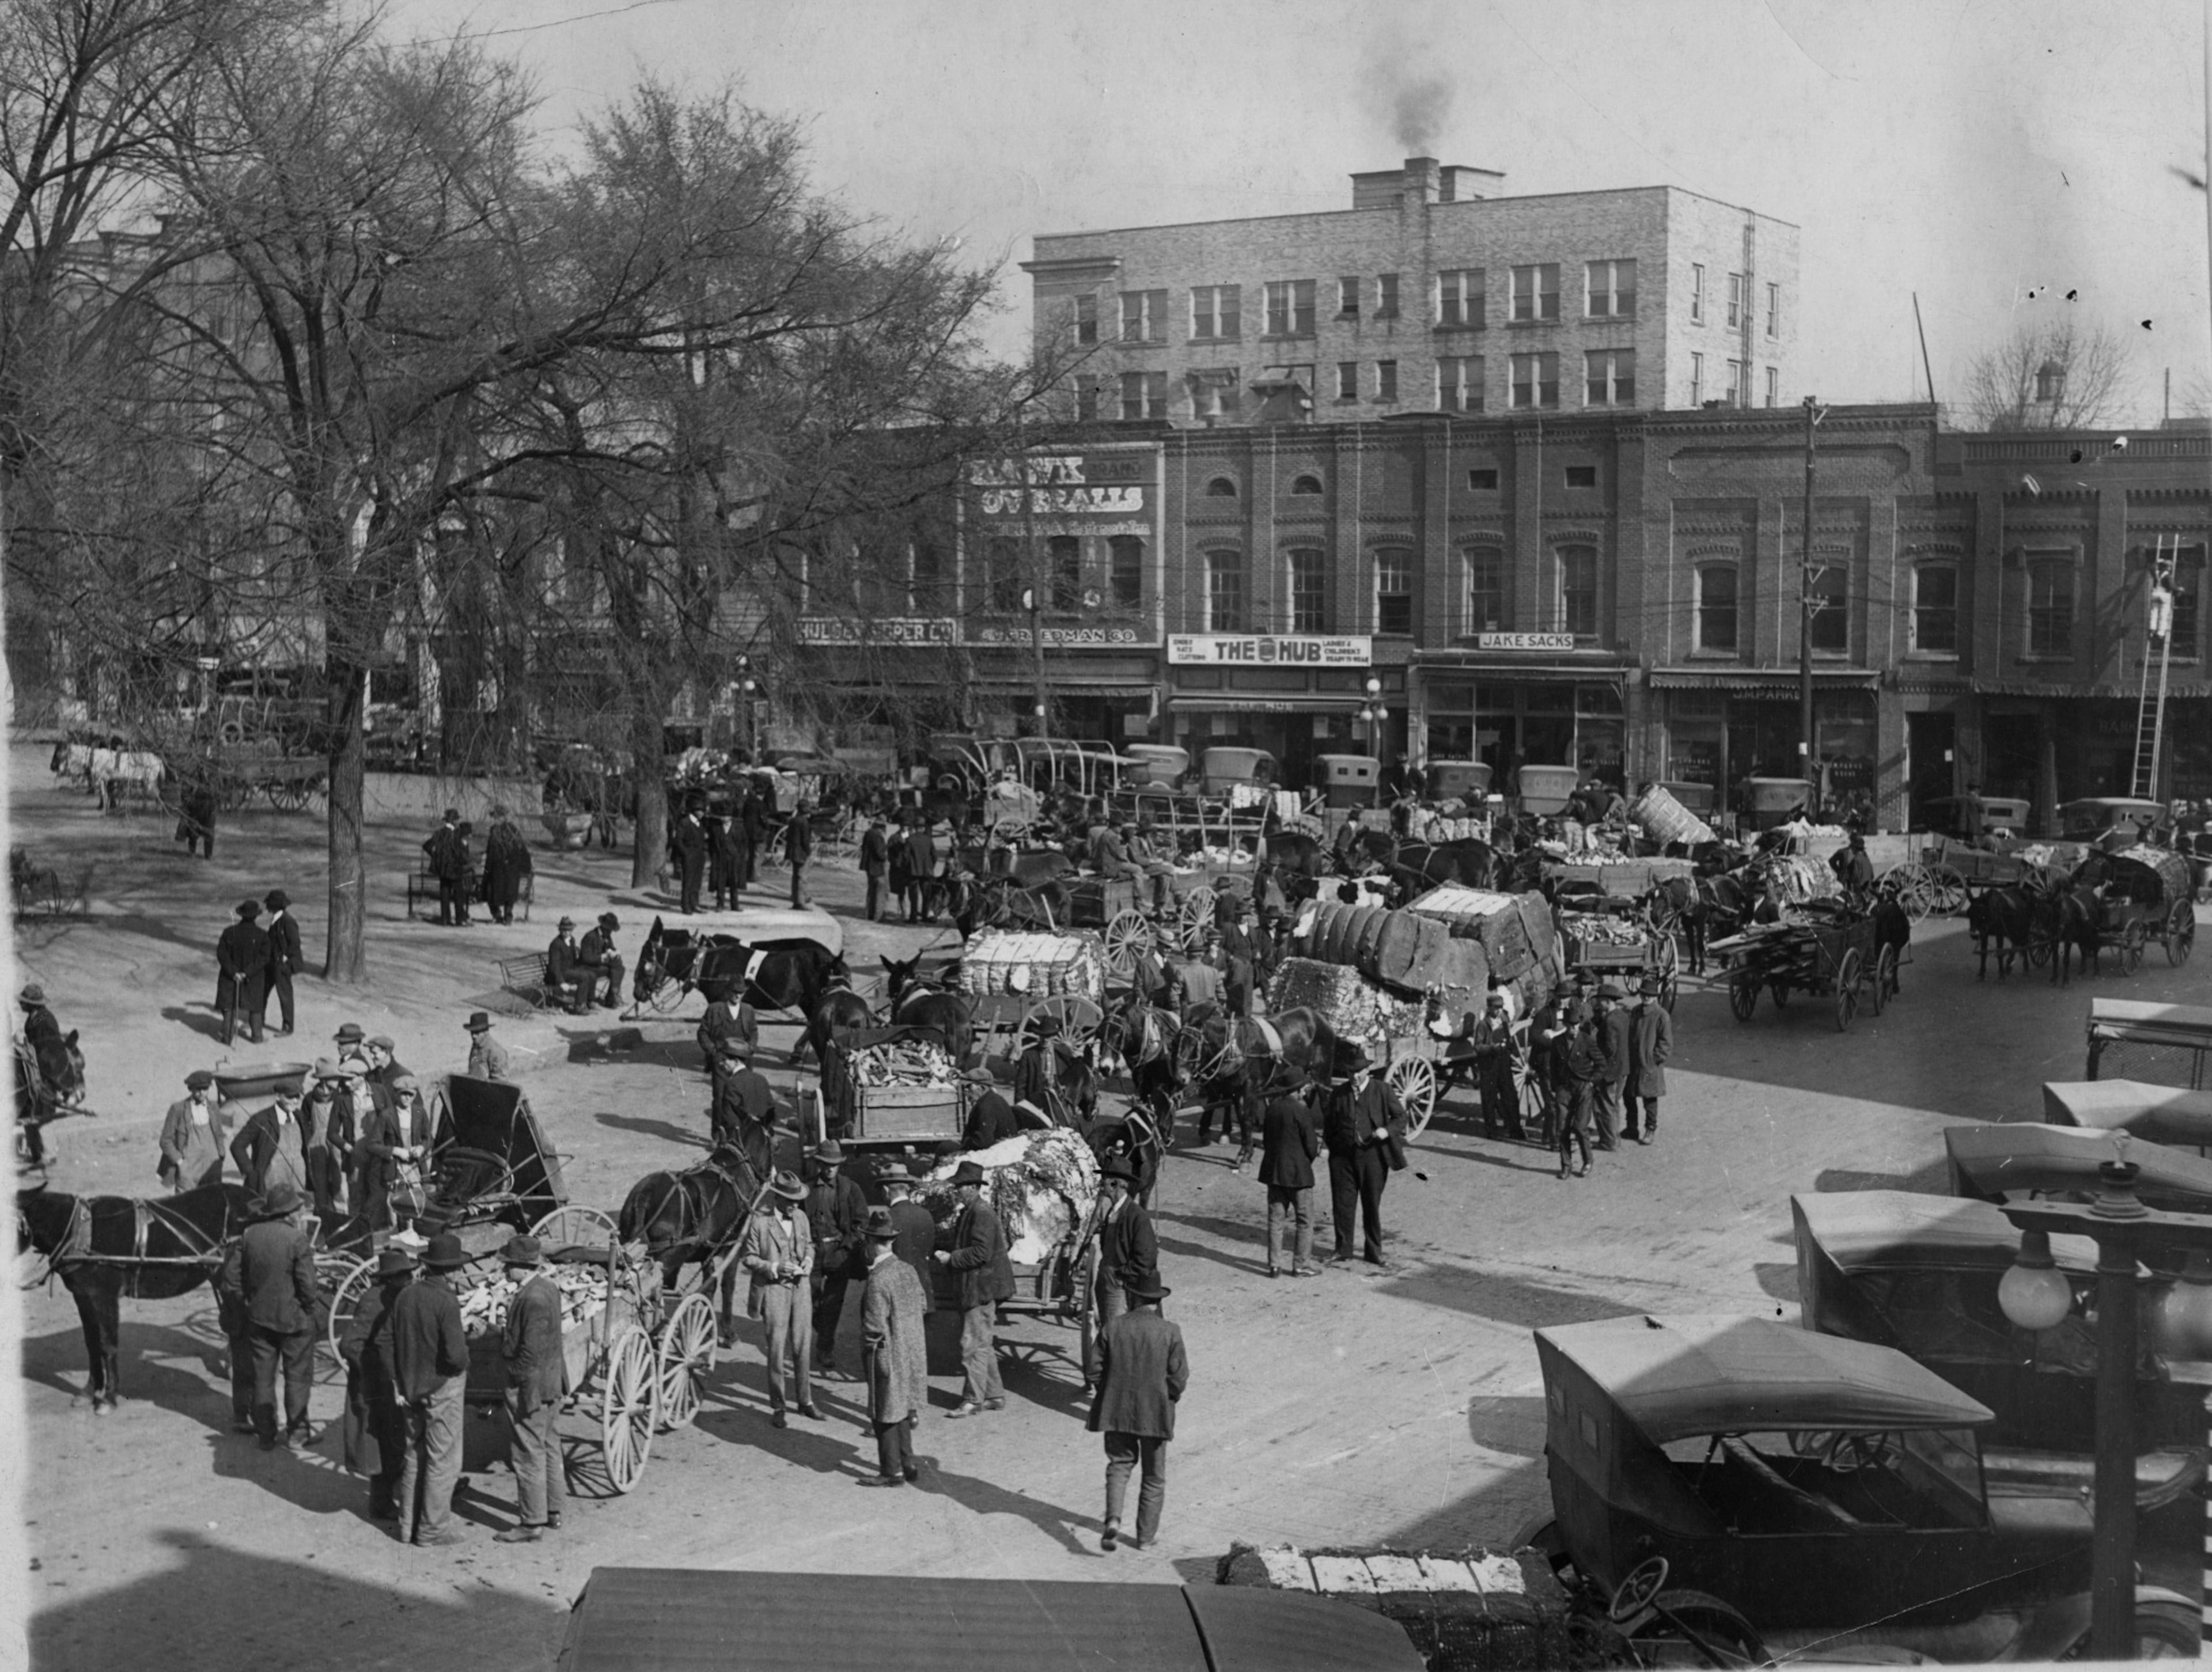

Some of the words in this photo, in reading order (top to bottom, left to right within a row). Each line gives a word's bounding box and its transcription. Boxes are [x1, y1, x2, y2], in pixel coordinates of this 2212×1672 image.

[982, 487, 1144, 514] OVERALLS
[1215, 641, 1255, 660] THE
[1279, 640, 1321, 662] HUB
[1483, 635, 1524, 646] JAKE
[1528, 635, 1572, 647] SACKS
